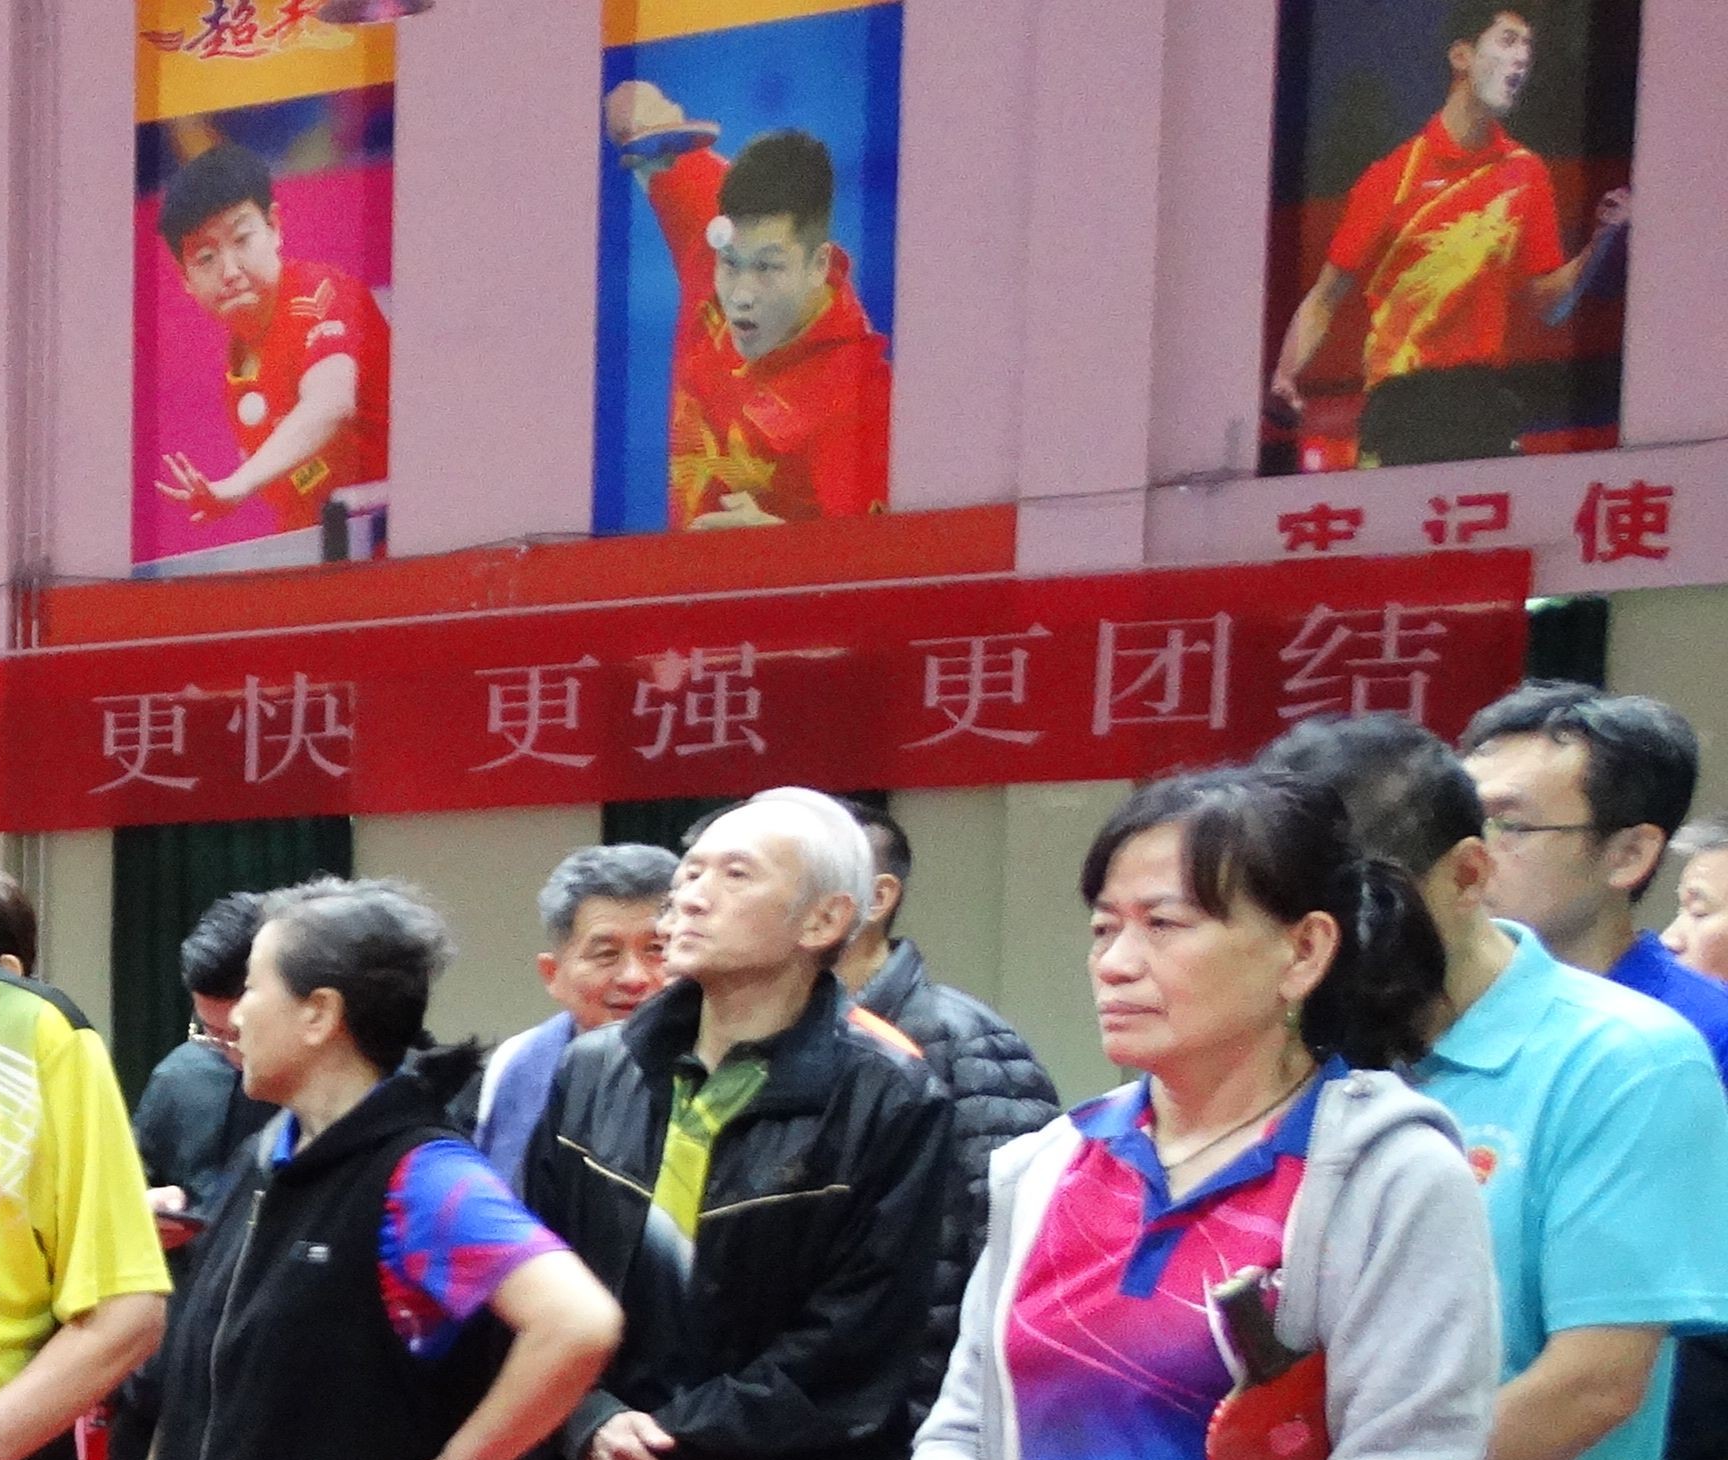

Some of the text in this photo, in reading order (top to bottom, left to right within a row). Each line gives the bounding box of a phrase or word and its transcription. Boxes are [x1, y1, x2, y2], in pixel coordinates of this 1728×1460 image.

[87, 672, 354, 794] 更快
[470, 641, 767, 773] 更强
[899, 602, 1448, 750] 更团结
